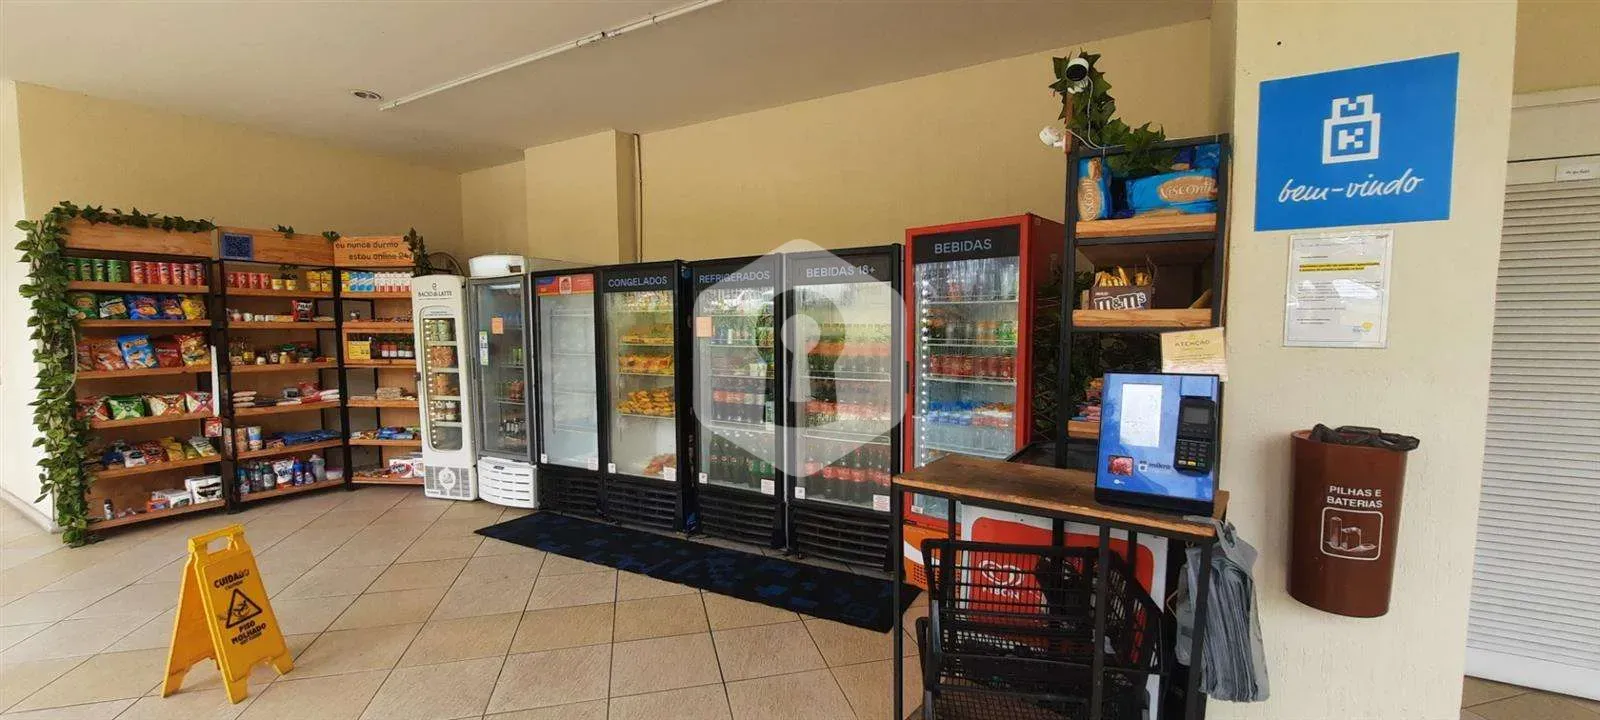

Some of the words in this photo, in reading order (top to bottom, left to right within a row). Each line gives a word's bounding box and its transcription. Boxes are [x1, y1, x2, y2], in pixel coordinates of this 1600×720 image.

[1278, 168, 1424, 203] bem-vindo
[372, 241, 399, 249] durmo
[934, 238, 992, 254] BEBIDAS
[699, 270, 770, 284] REFRIGERADOS
[805, 266, 855, 278] BEBIDAS
[858, 264, 876, 275] 18+
[608, 275, 668, 288] CONGELADOS
[1174, 339, 1210, 347] ATENÇÃO
[1329, 485, 1372, 497] PILHAS
[1374, 489, 1382, 497] E
[1326, 496, 1383, 508] BATERIAS
[213, 568, 250, 589] CUIDADO
[238, 620, 256, 633] PISO
[231, 623, 267, 645] MOLHADO
